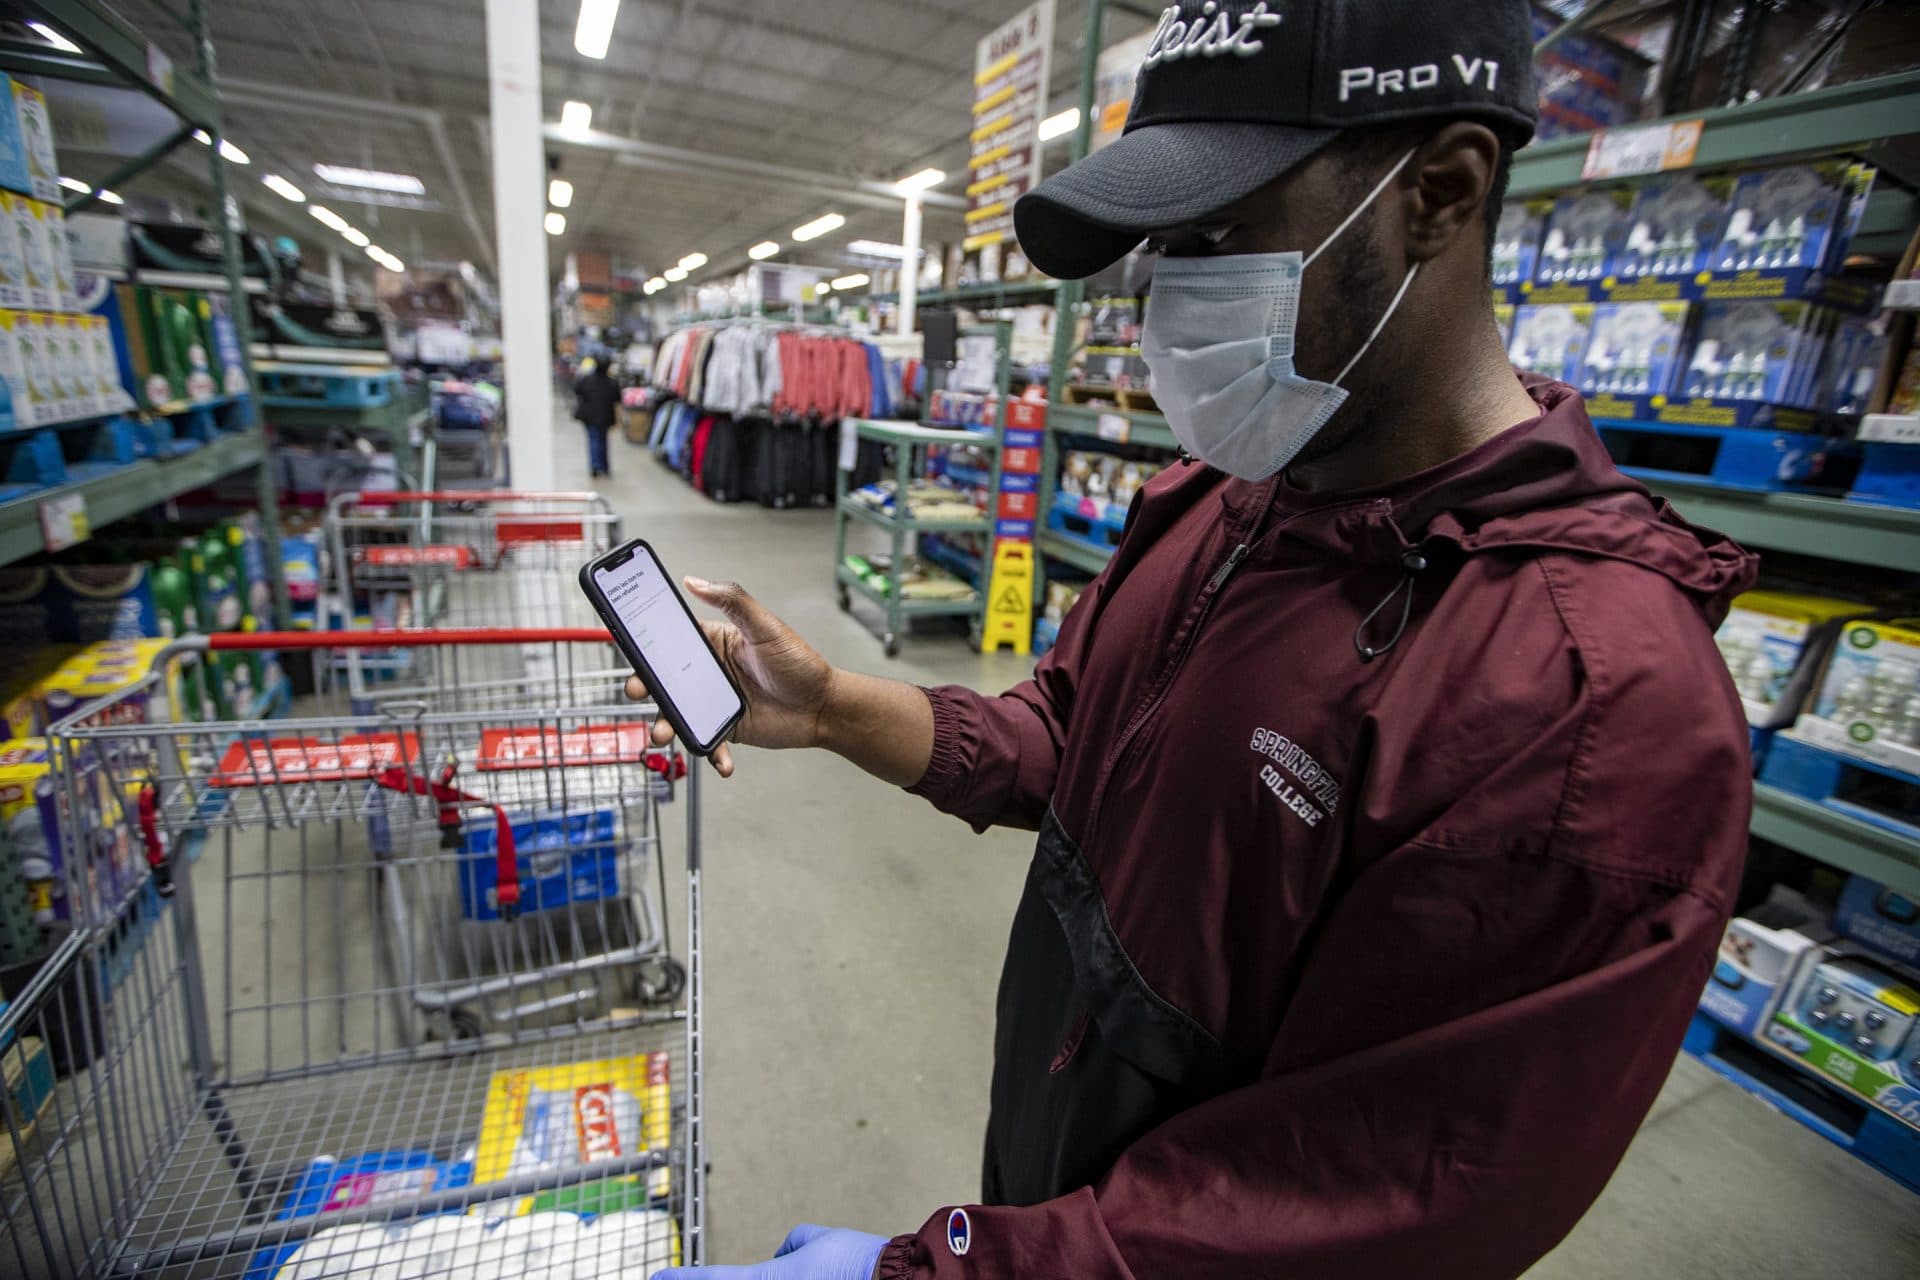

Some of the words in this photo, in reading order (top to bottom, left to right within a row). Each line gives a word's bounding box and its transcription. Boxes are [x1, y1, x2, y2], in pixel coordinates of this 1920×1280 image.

[1452, 54, 1499, 91] V1
[611, 594, 622, 604] been
[622, 583, 640, 598] refunded
[1260, 764, 1323, 827] COLLEGE
